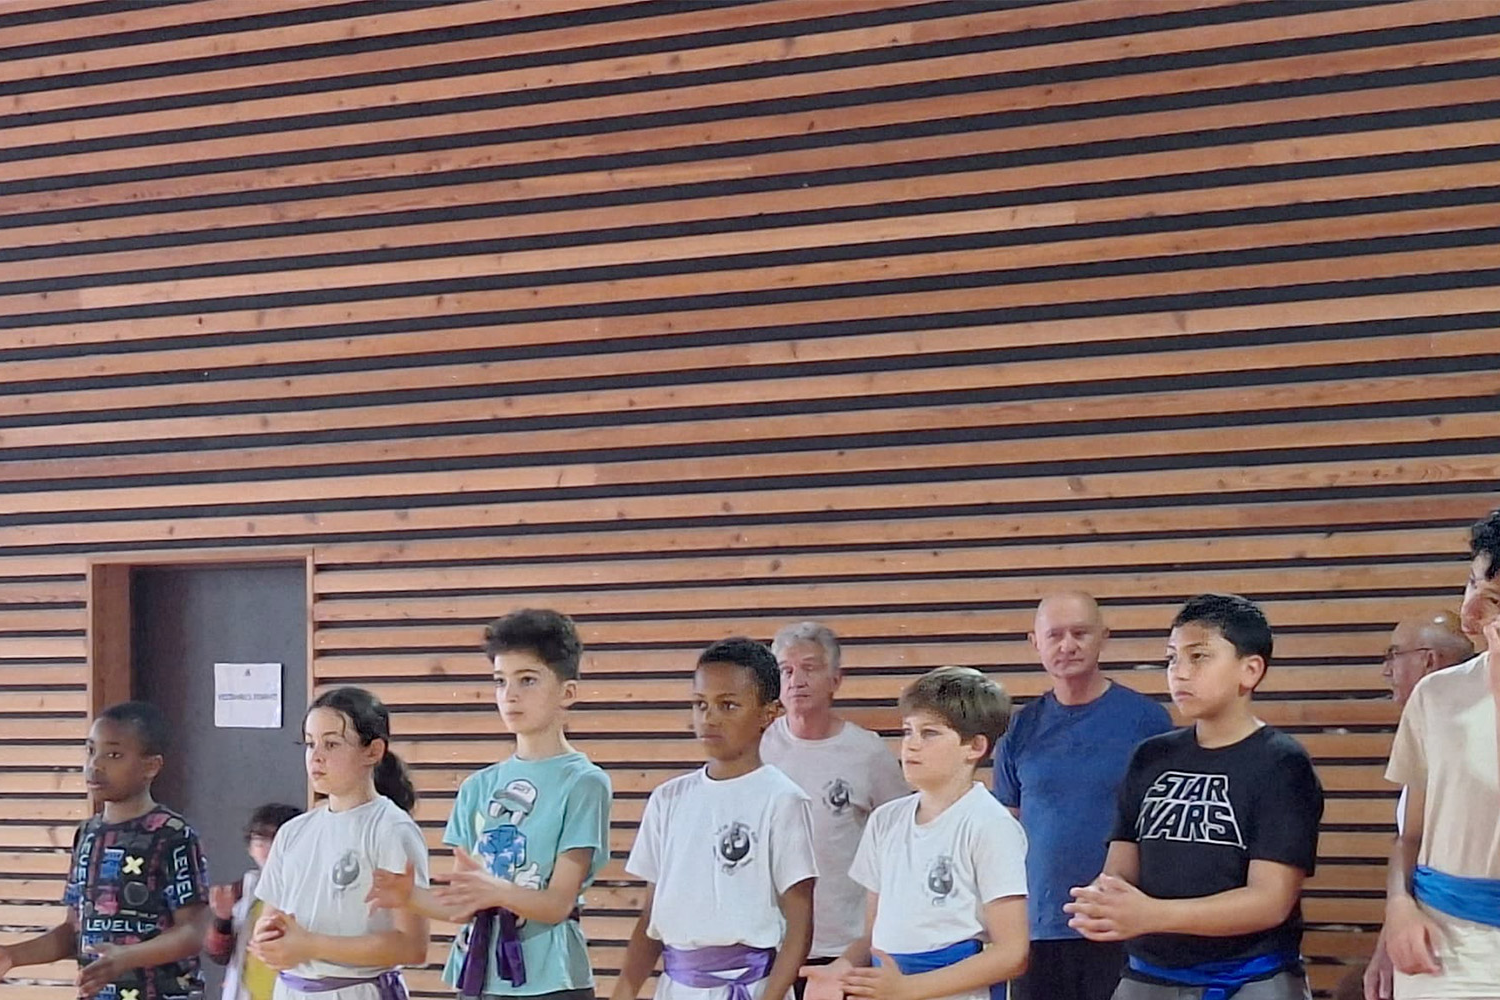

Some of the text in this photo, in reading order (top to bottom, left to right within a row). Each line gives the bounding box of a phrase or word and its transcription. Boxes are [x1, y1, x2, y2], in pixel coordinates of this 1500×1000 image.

[1144, 771, 1230, 803] STAR
[1135, 799, 1244, 847] WARS
[173, 844, 193, 905] LEVEL
[86, 918, 133, 932] LEVEL
